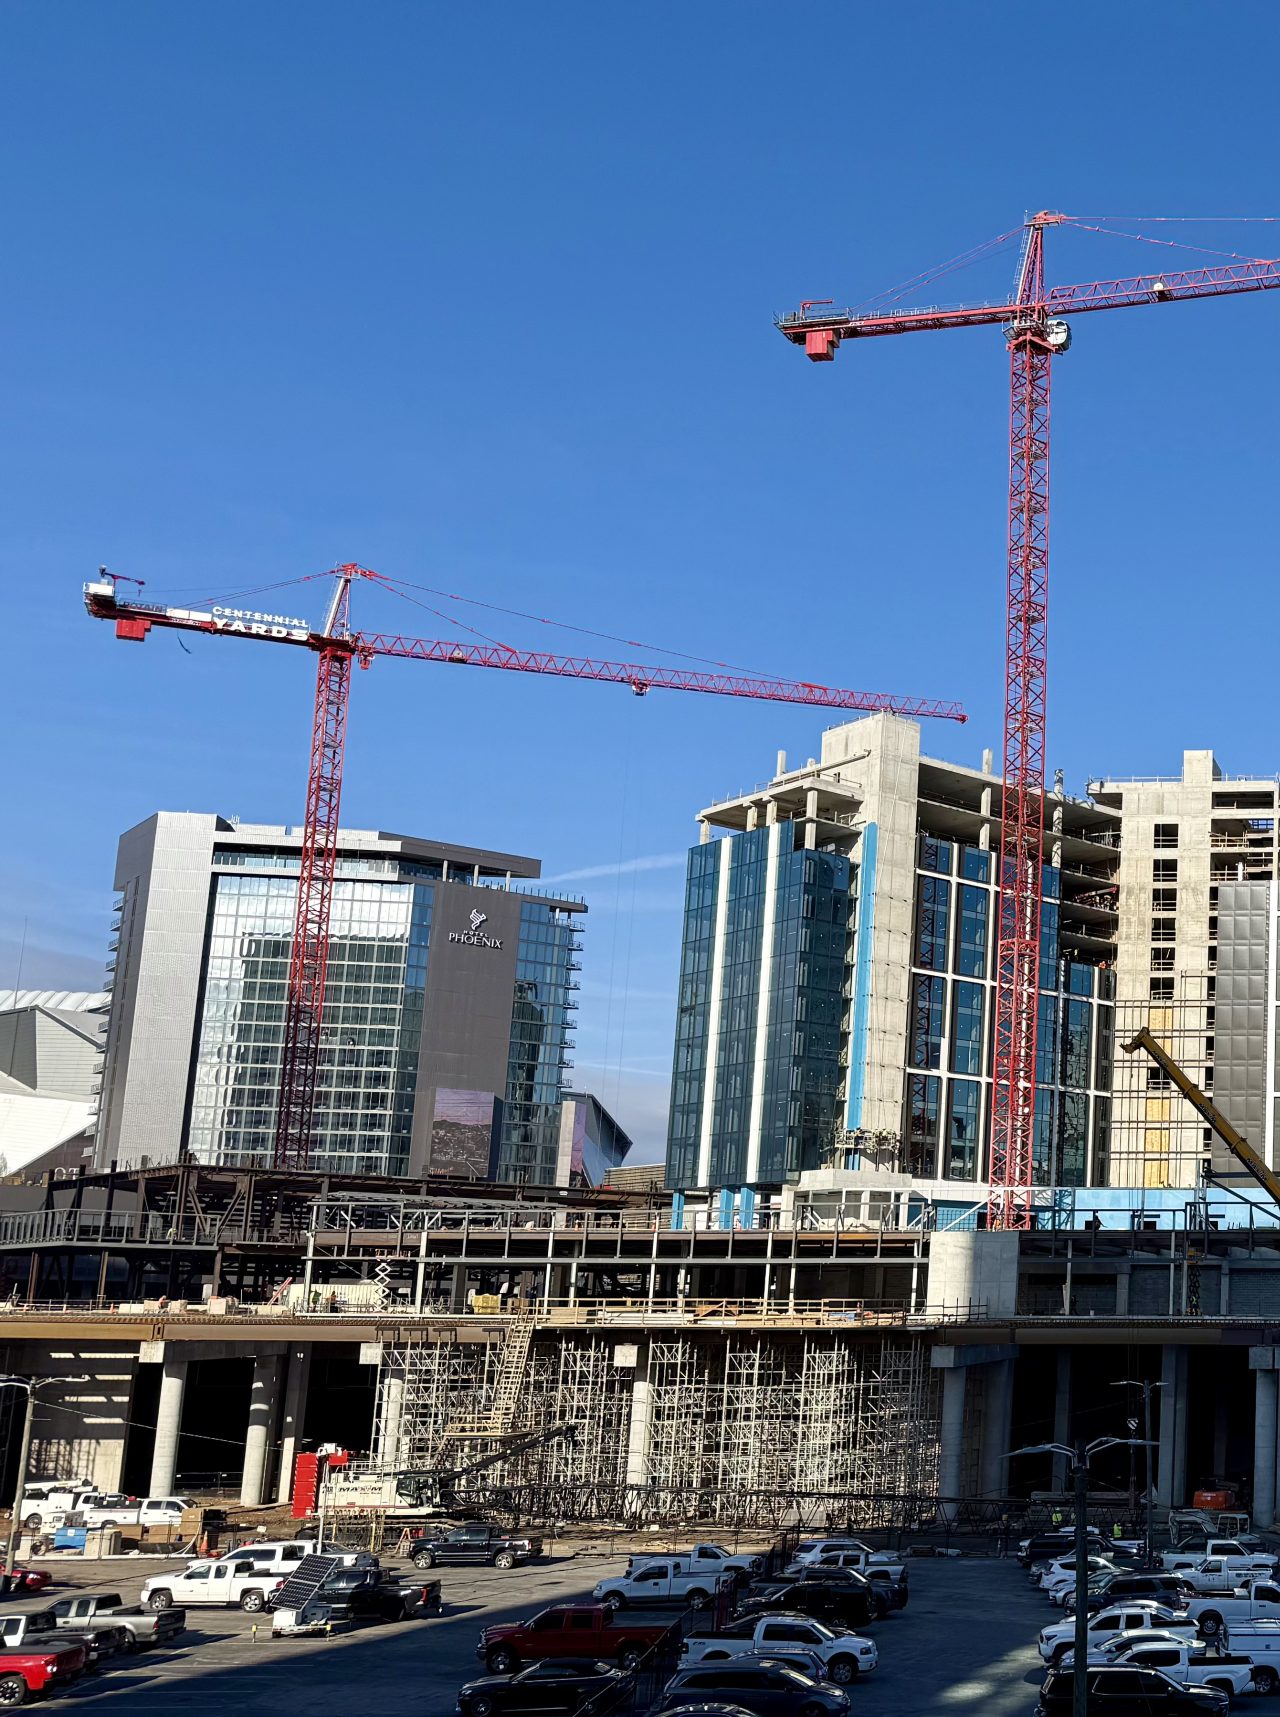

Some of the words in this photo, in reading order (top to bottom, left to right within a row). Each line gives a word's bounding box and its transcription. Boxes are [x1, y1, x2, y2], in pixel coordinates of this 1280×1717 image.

[212, 606, 308, 628] CENTENNIAL
[213, 616, 309, 641] YARDS
[448, 932, 502, 949] PHOENIX
[463, 929, 488, 937] HOTEL
